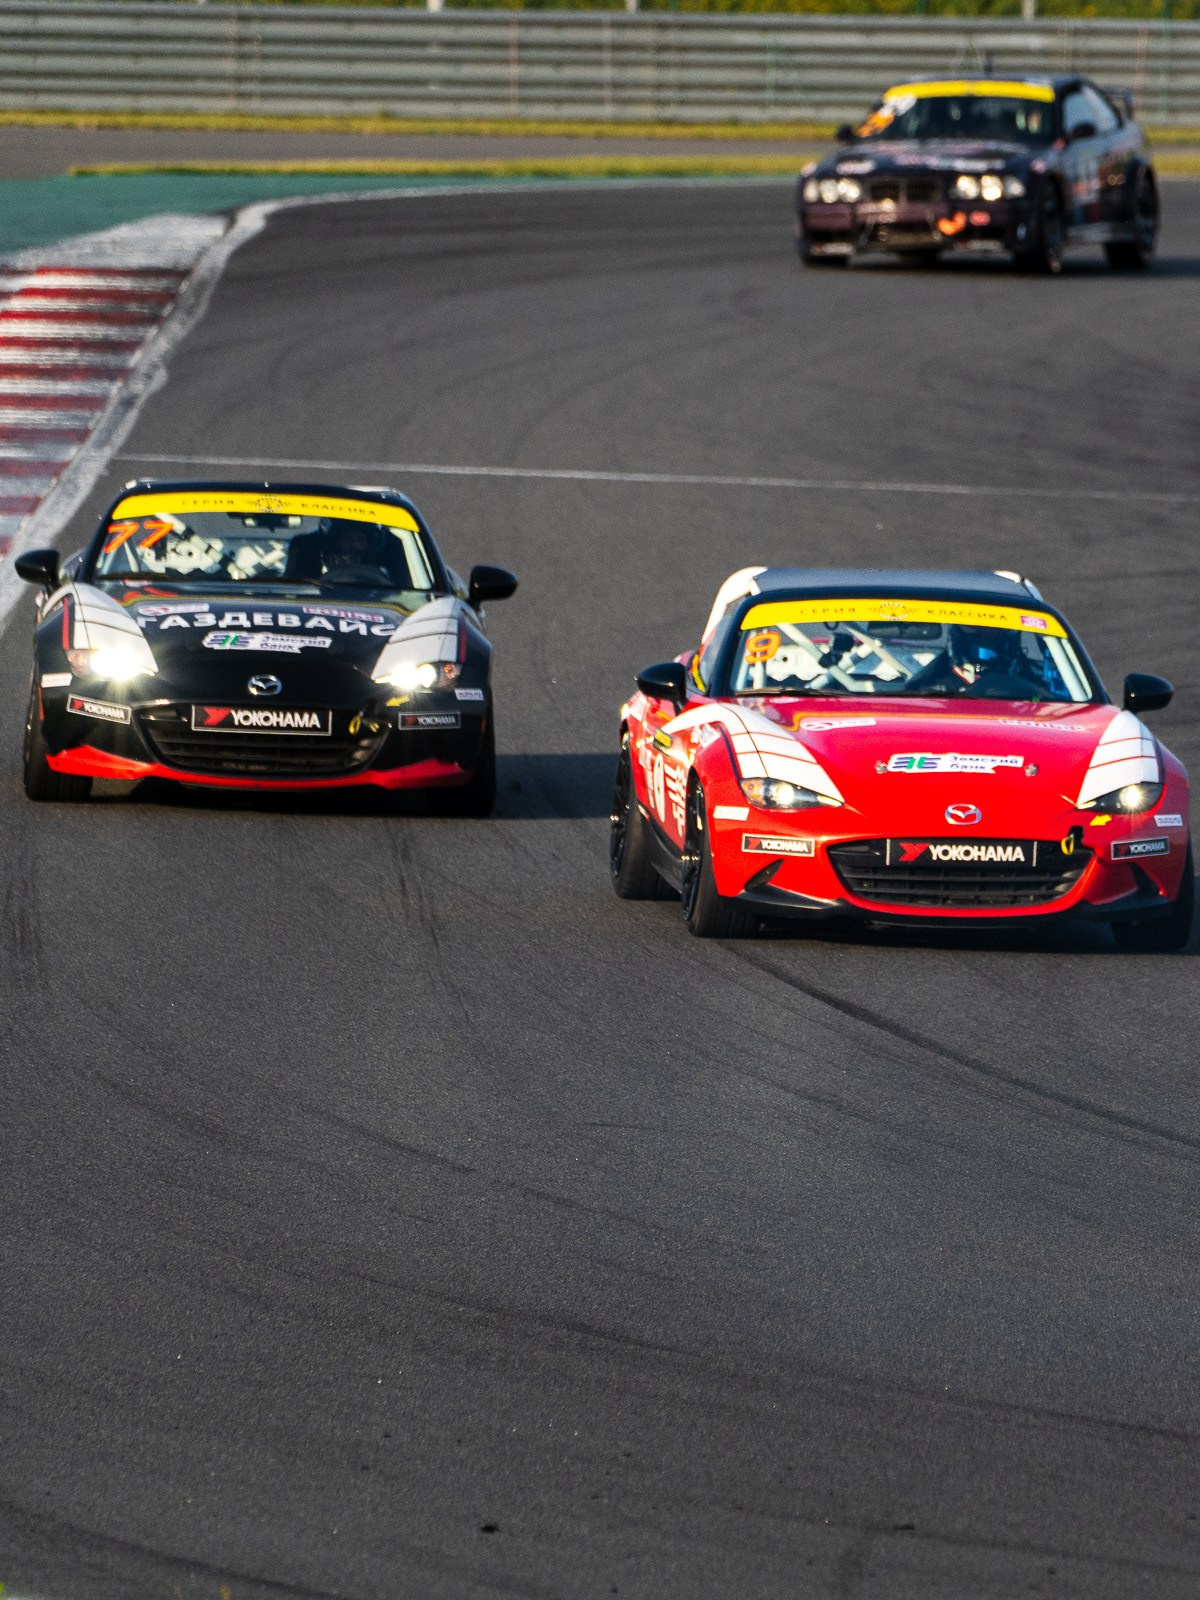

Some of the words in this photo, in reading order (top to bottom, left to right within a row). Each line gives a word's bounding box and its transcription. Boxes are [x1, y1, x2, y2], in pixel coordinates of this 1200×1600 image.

[104, 521, 174, 554] 77
[136, 612, 396, 636] ГАЗДЕВАЙС
[927, 609, 1008, 621] КЛАССИКА
[745, 631, 782, 665] 9
[231, 709, 321, 729] YOKOHAMA
[950, 755, 1019, 765] Земский
[761, 838, 809, 853] YOKOHAMA
[929, 844, 1025, 862] YOKOHAMA
[1129, 841, 1165, 854] YOKOHAMA
